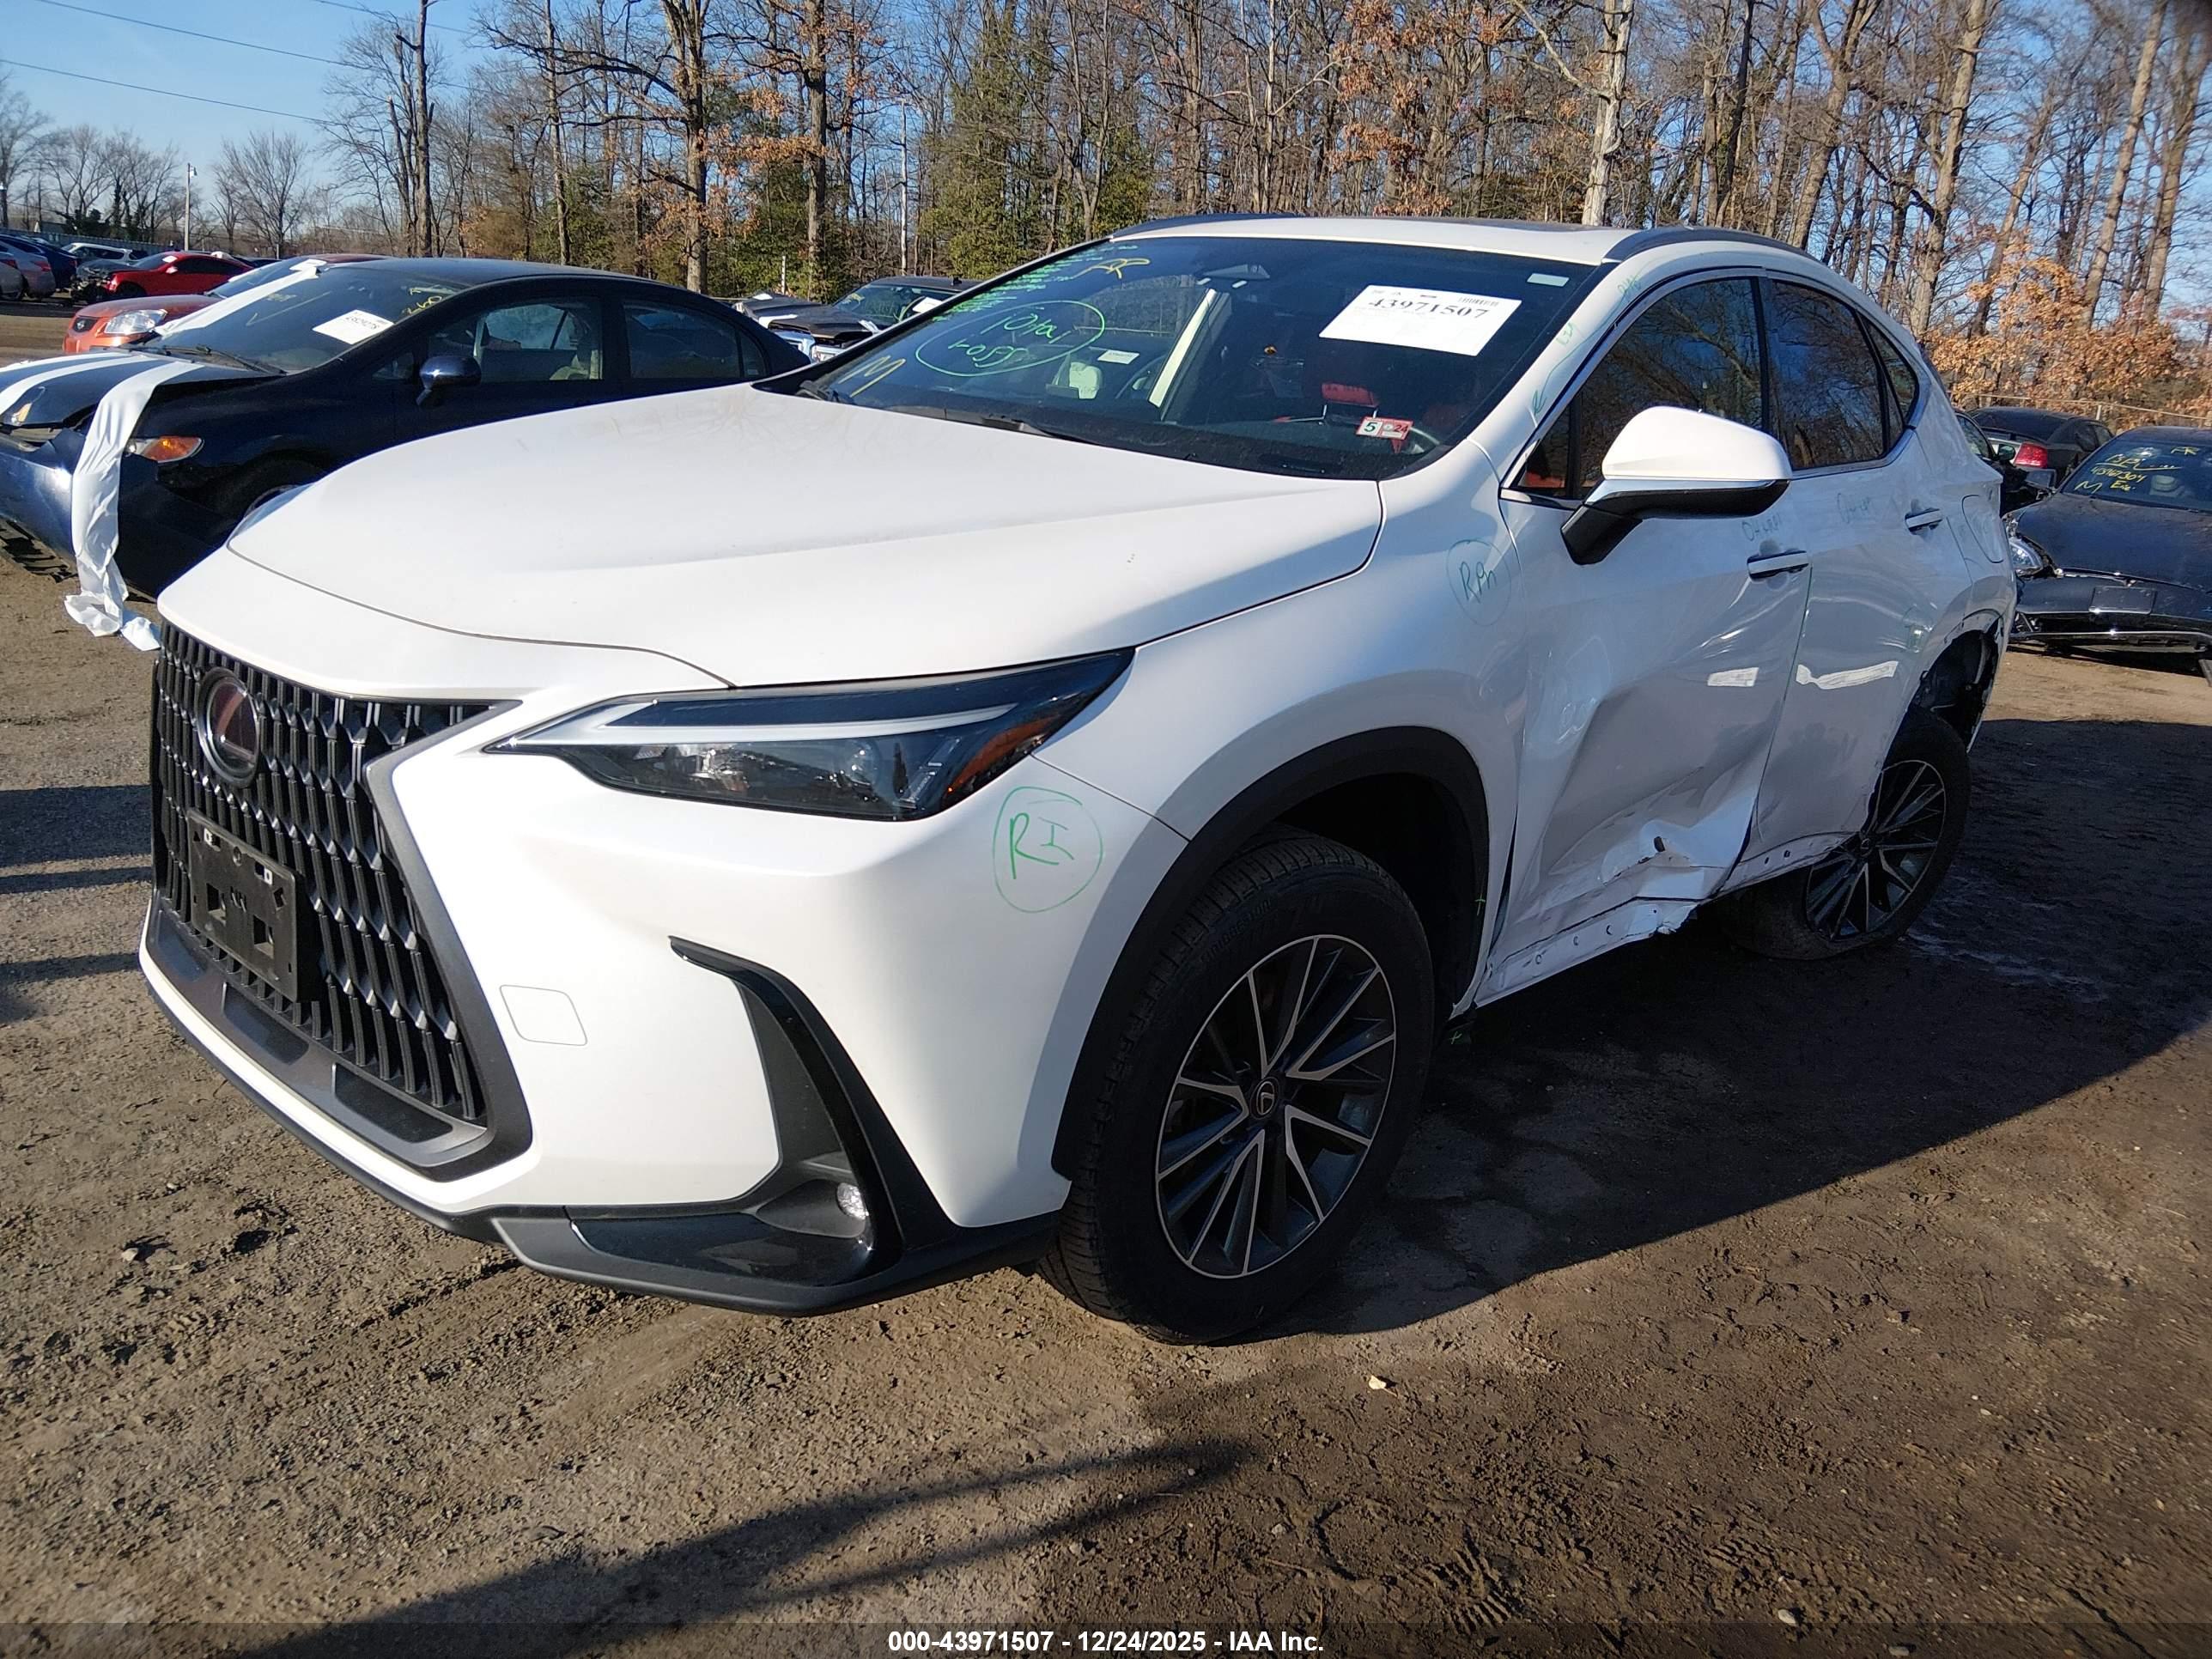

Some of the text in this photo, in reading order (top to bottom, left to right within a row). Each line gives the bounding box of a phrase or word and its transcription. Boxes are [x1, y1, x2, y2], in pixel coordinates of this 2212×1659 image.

[1367, 297, 1489, 319] 43971507
[1364, 422, 1409, 433] 5 24
